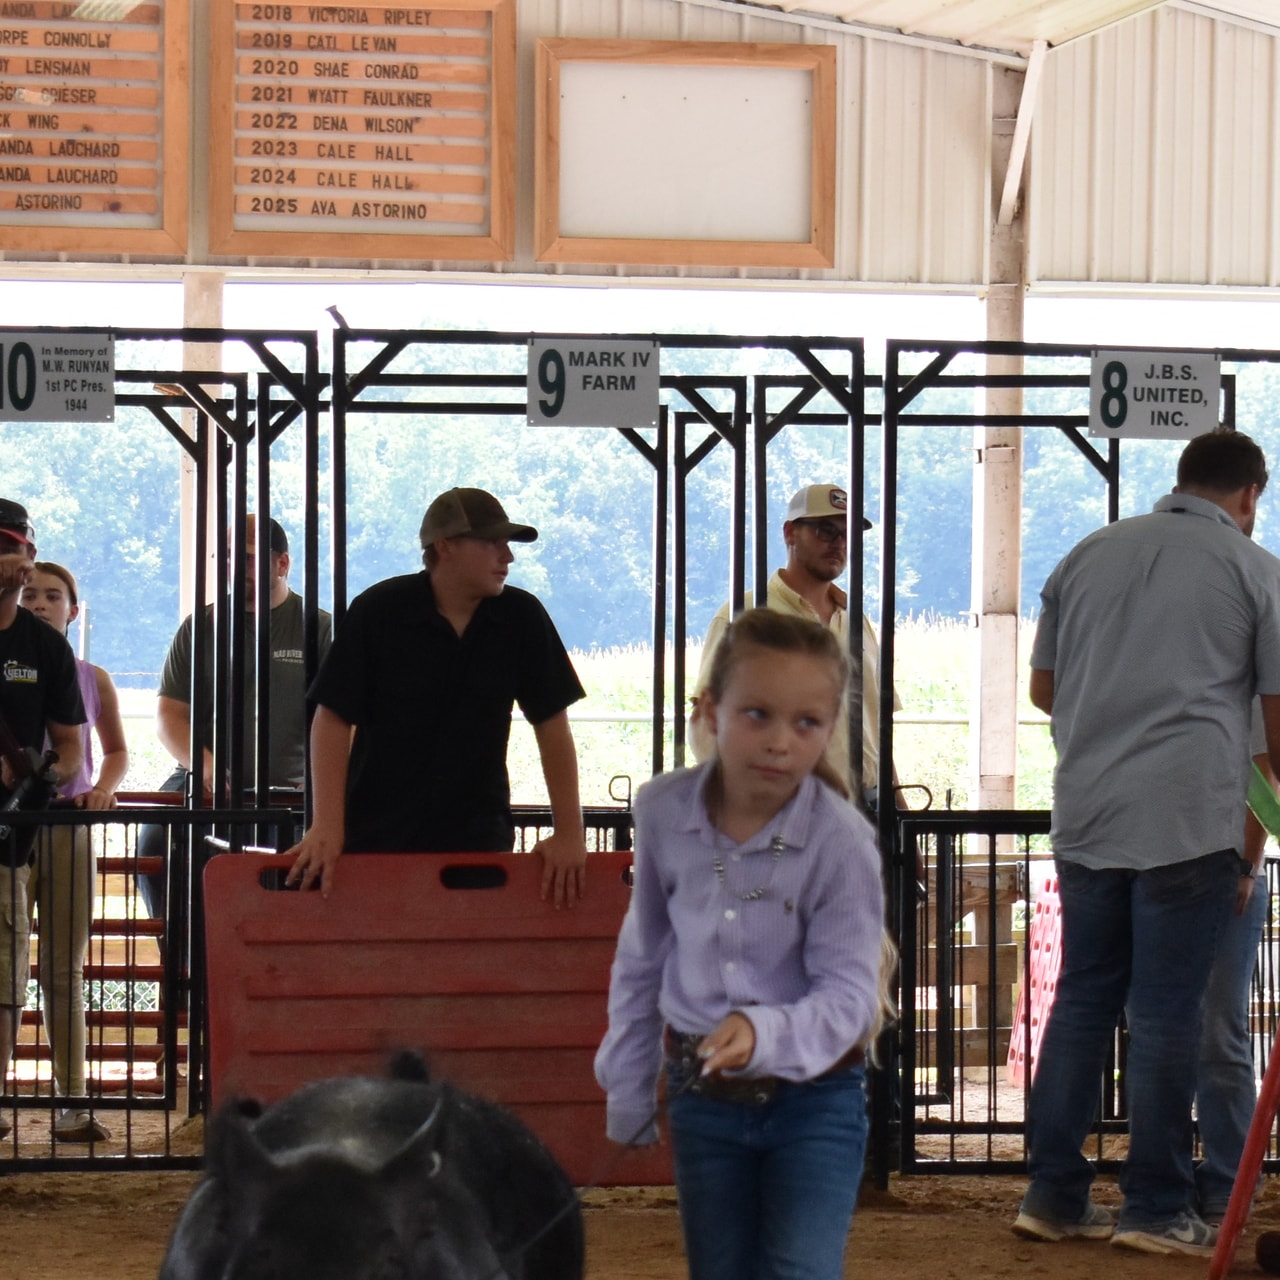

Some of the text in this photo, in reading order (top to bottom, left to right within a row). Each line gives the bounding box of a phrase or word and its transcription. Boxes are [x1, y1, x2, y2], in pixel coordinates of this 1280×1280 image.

[252, 6, 432, 26] 2018 VICTORIA RIPLEY
[43, 31, 111, 49] CONNOLLY
[252, 33, 293, 49] 2019
[26, 59, 91, 76] LENSMAN
[252, 60, 419, 81] 2020 SHAE CONRAD
[251, 87, 432, 108] 2021 WYATT FAULKNER
[27, 114, 59, 130] WING
[251, 114, 414, 134] 2022 DENA WILSON
[49, 141, 120, 158] LAUCHARD
[251, 141, 414, 162] 2023 CALE HALL
[47, 168, 118, 185] LAUCHARD
[250, 169, 414, 190] 2024 CALE HALL
[15, 195, 82, 211] ASTORINO
[251, 198, 427, 220] 2025 AVA ASTORINO
[41, 346, 108, 358] In Memory of
[569, 351, 651, 368] MARK IV
[42, 360, 109, 373] M.W. RUNYAN
[1145, 364, 1198, 381] J.B.S.
[45, 380, 107, 393] 1st PC Pres.
[538, 348, 566, 418] 9
[582, 375, 636, 391] FARM
[1100, 360, 1128, 429] 8
[1133, 387, 1208, 407] UNITED,
[65, 399, 87, 411] 1944
[1150, 411, 1189, 427] INC.
